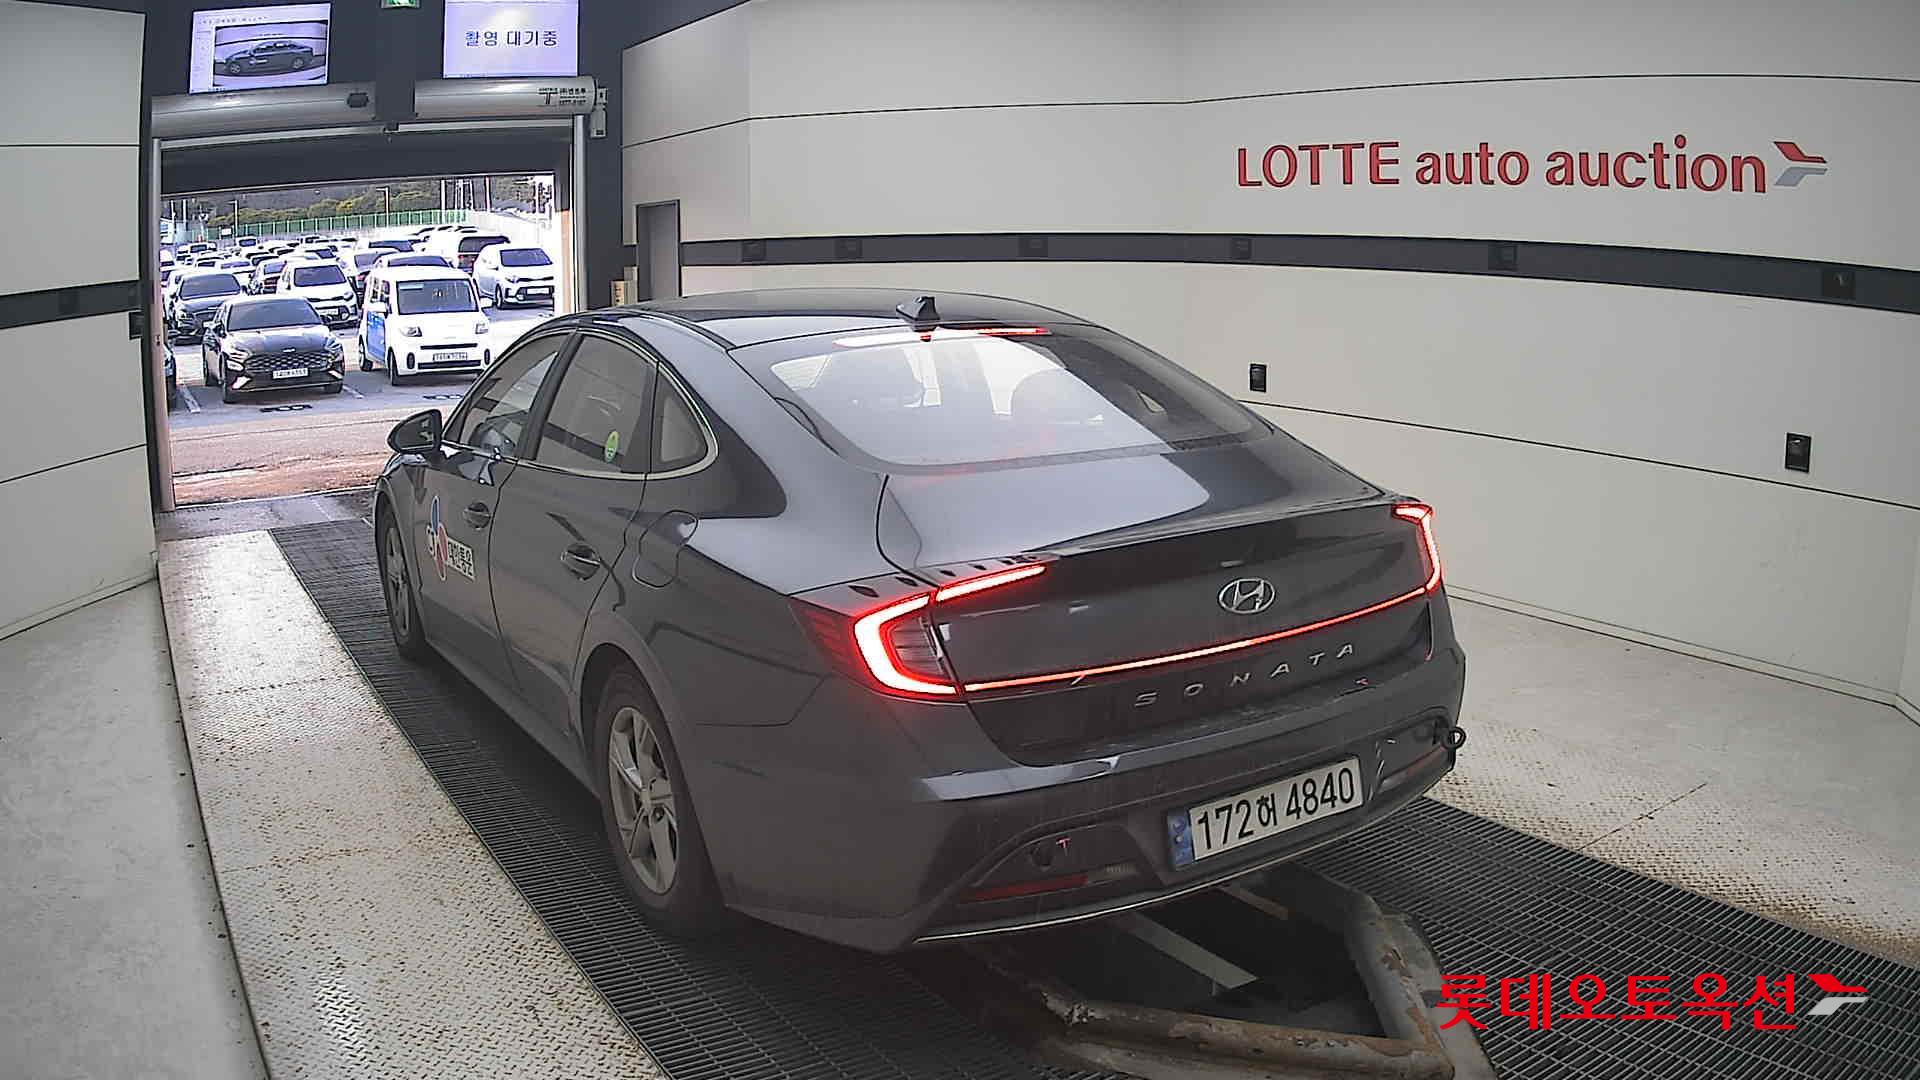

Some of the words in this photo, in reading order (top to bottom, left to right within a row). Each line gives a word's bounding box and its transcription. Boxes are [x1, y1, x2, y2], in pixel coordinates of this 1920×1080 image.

[506, 31, 557, 47] 대기중
[1237, 141, 1399, 188] LOTTE
[1415, 143, 1530, 187] auto
[1545, 135, 1768, 194] auction
[1134, 643, 1354, 707] SONATA
[1197, 792, 1278, 850] 172허
[1285, 767, 1355, 820] 4840
